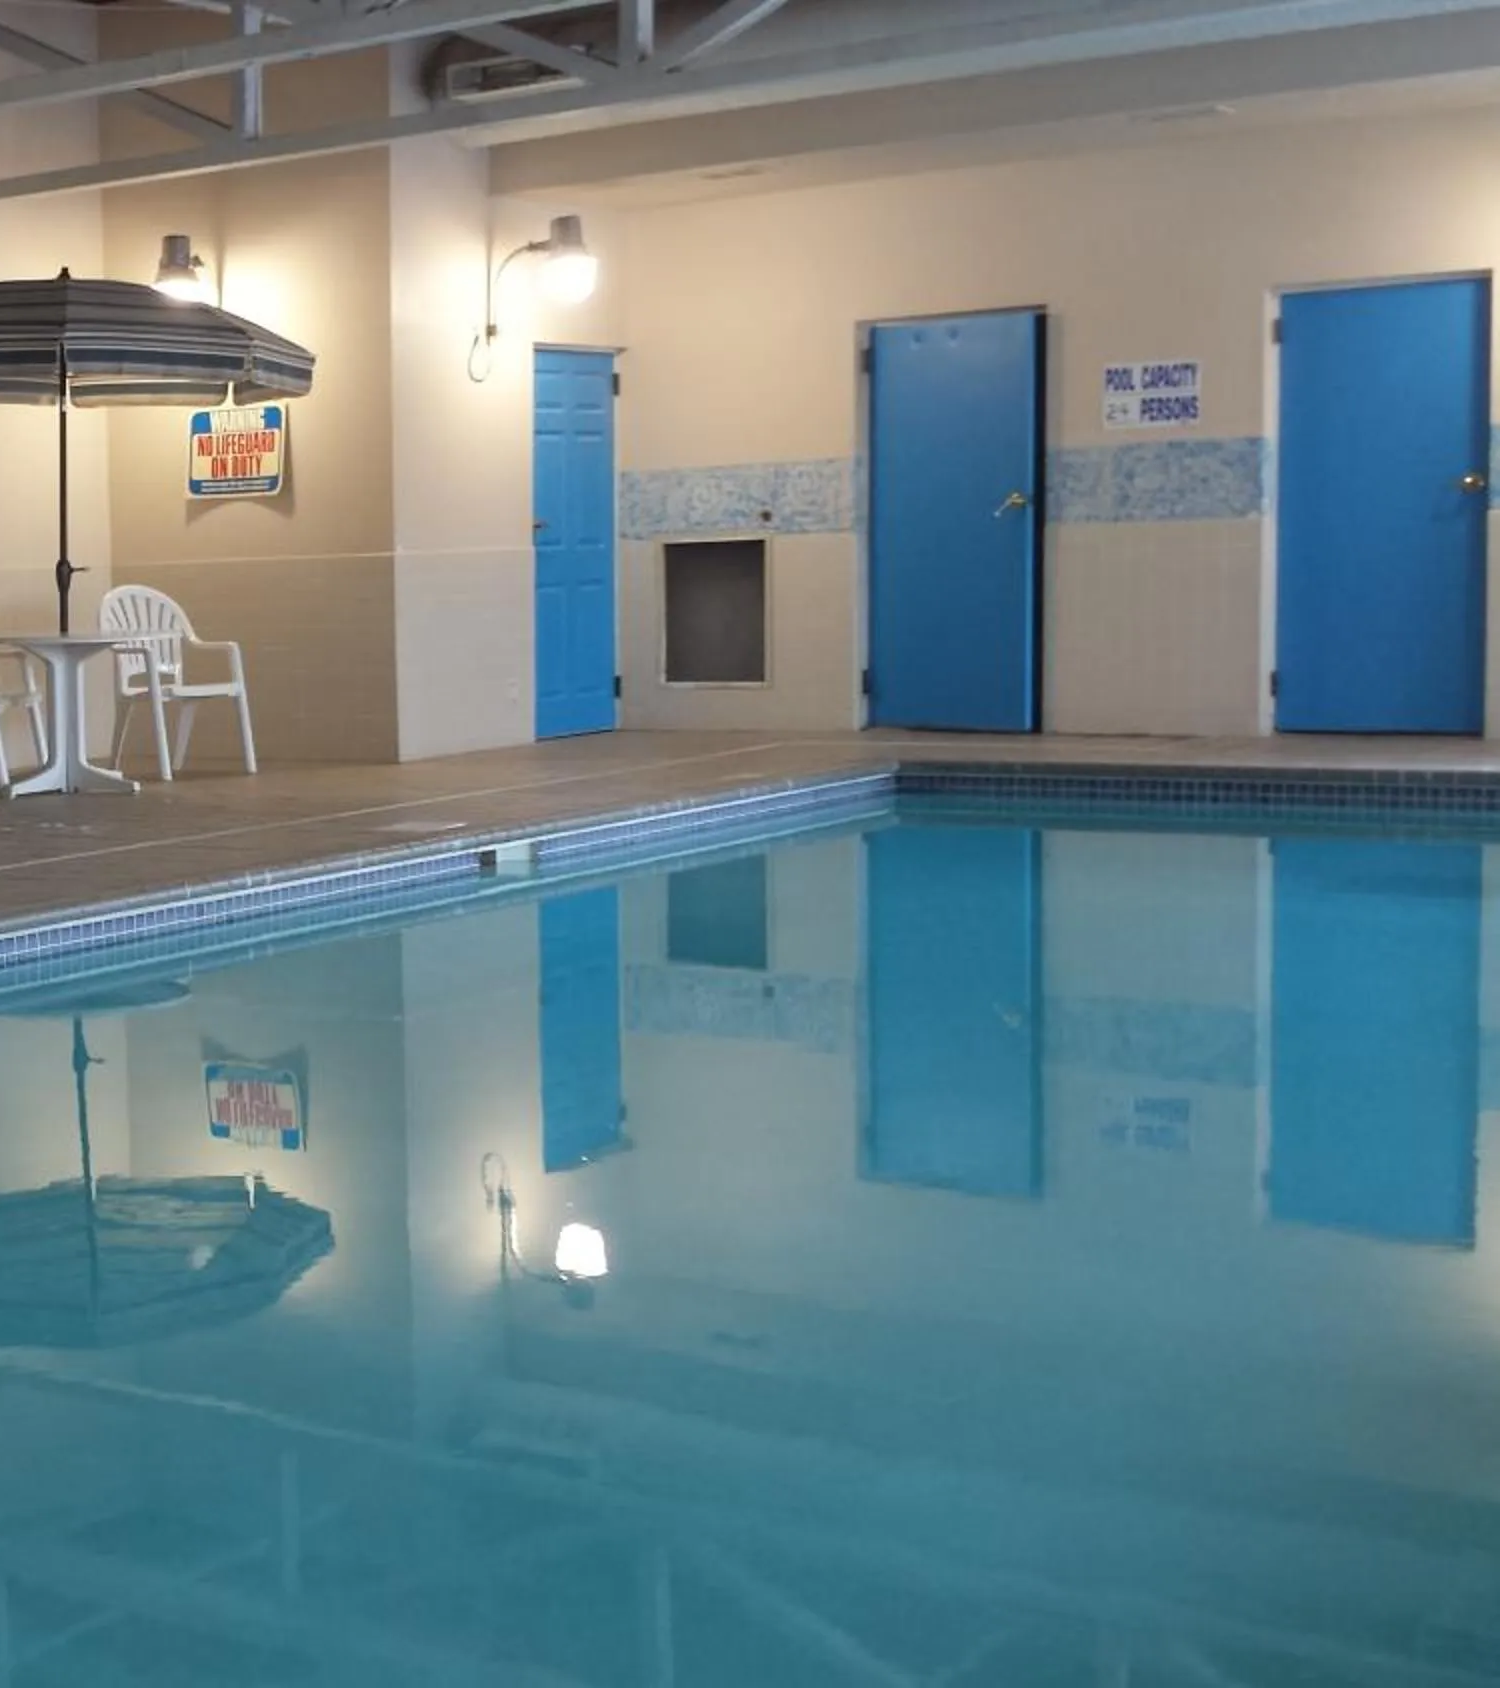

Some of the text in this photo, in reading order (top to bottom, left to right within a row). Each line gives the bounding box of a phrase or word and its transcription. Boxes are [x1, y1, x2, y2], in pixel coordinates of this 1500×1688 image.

[1104, 362, 1197, 391] POOL CAPACITY
[1140, 396, 1198, 422] PERSONS
[197, 431, 275, 457] NO LIFEGUARD
[211, 455, 263, 478] ON DUTY
